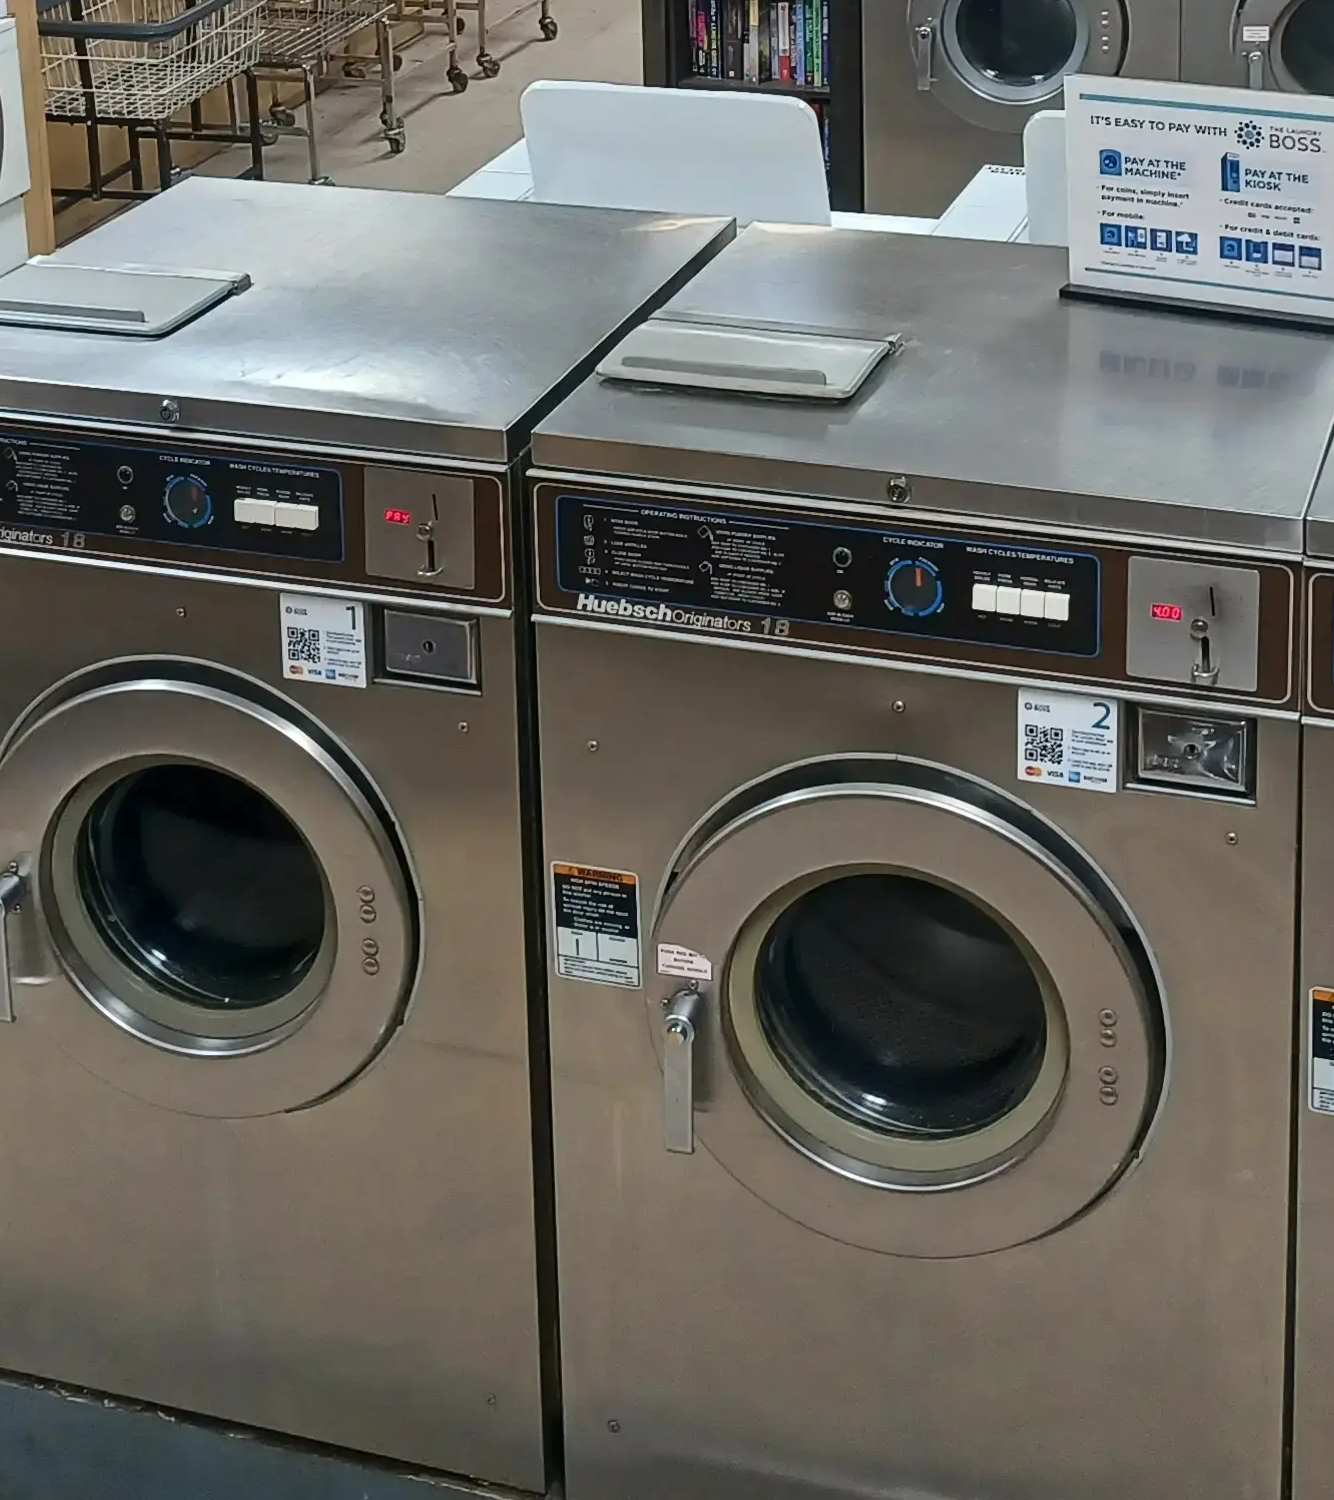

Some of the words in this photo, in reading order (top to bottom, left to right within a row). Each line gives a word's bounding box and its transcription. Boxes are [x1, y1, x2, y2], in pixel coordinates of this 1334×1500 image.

[1090, 115, 1112, 127] IT'S
[1114, 117, 1145, 131] EASY
[1148, 120, 1165, 132] TO
[1168, 122, 1191, 135] PAY
[1194, 124, 1228, 137] WITH
[1269, 125, 1284, 133] THE
[1286, 127, 1322, 137] LAUNDRY
[1269, 134, 1322, 153] BOSS
[1124, 156, 1146, 168] PAY
[1147, 158, 1163, 169] AT
[1164, 160, 1187, 171] THE
[1244, 168, 1267, 180] PAY
[1268, 170, 1284, 182] AT
[1286, 172, 1310, 184] THE
[1101, 184, 1115, 192] For
[1116, 187, 1139, 196] coins,
[1140, 188, 1166, 200] simply
[1167, 191, 1190, 200] insert
[1244, 179, 1282, 192] KIOSK
[1101, 194, 1135, 206] payment
[1136, 196, 1144, 204] in
[1224, 198, 1249, 208] Credit
[1250, 200, 1273, 210] cards
[1274, 202, 1315, 215] accepted:
[1102, 210, 1115, 218] For
[1116, 211, 1145, 221] mobile:
[1224, 223, 1238, 232] For
[1240, 225, 1264, 235] credit
[1272, 229, 1295, 239] debit
[1296, 231, 1321, 242] cards:
[159, 454, 179, 463] CYCLE
[229, 463, 246, 472] WASH
[640, 508, 678, 520] OPERATING
[679, 512, 728, 526] INSTRUCTIONS
[882, 537, 906, 546] CYCLE
[907, 539, 944, 549] INDICATOR
[966, 545, 987, 556] WASH
[345, 605, 357, 631] 1
[1091, 701, 1111, 730] 2
[1047, 770, 1064, 778] VISA
[576, 867, 623, 882] WARNING
